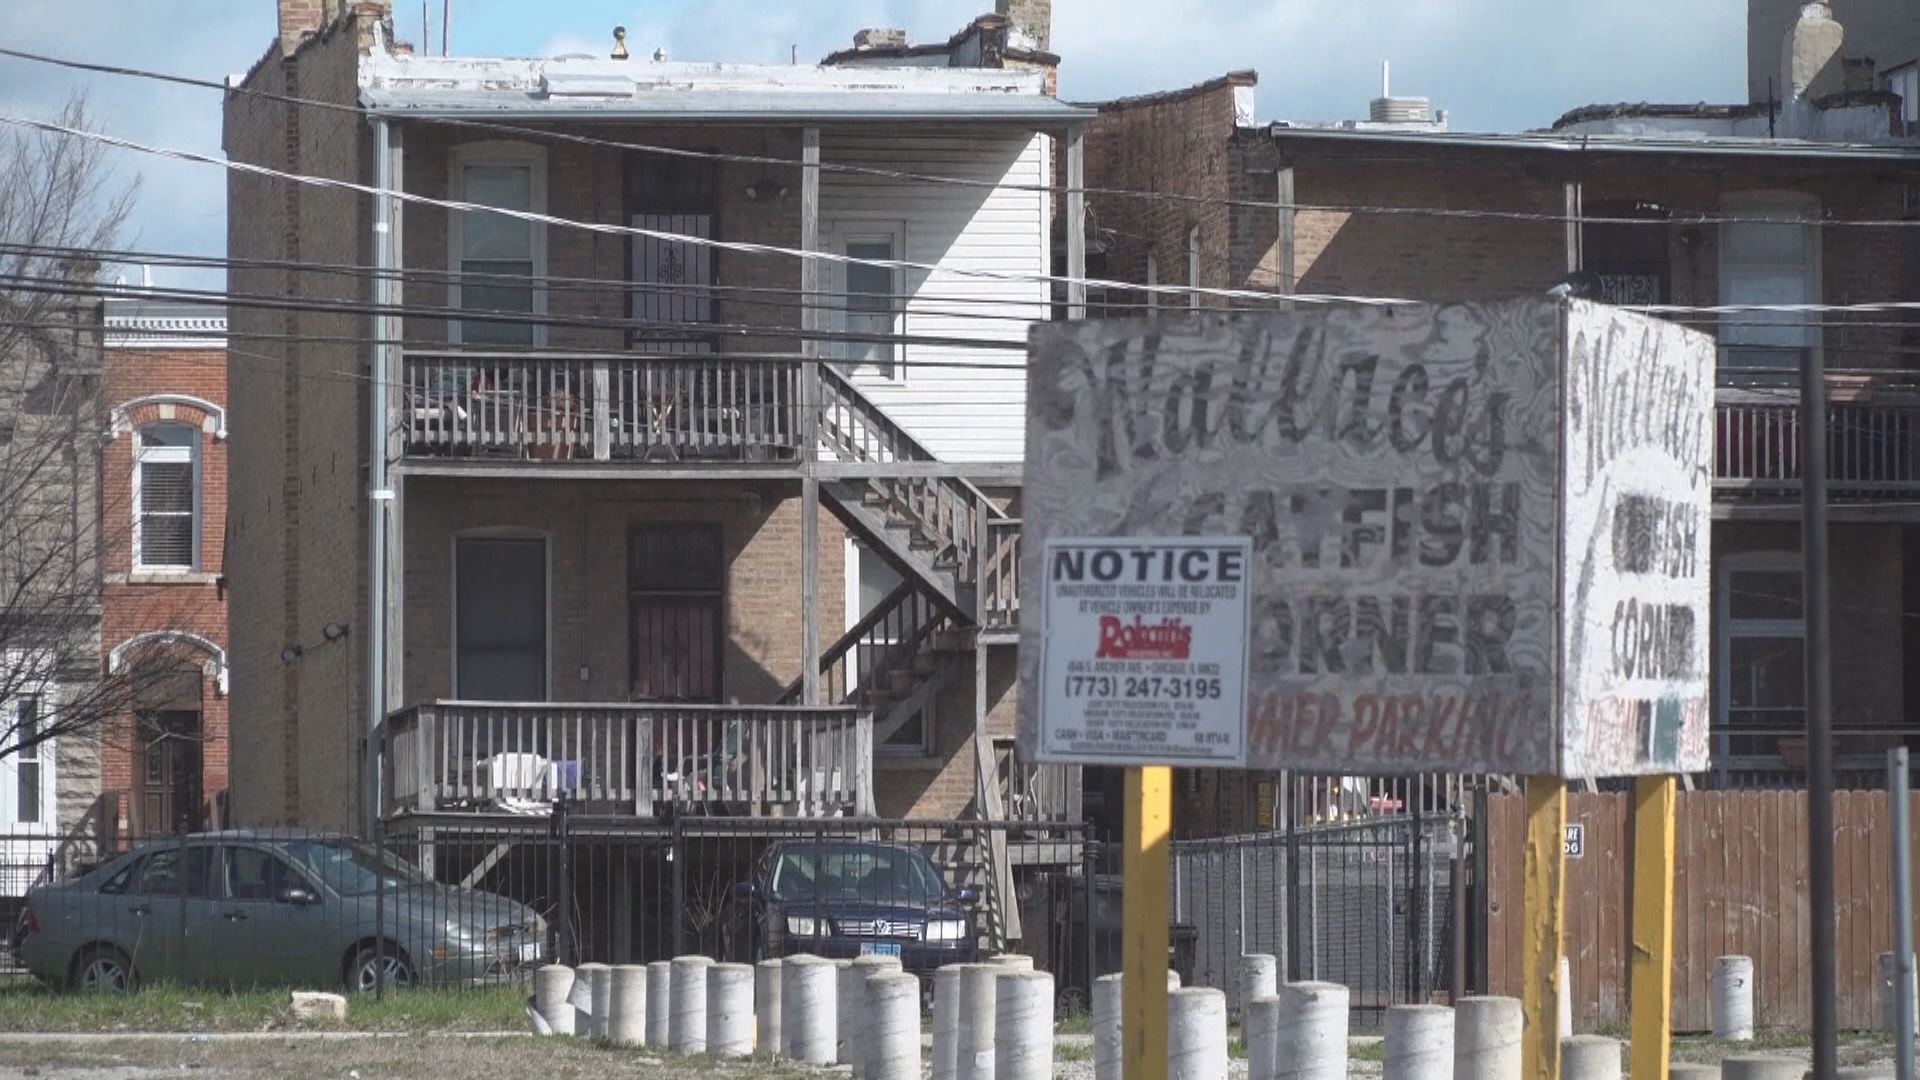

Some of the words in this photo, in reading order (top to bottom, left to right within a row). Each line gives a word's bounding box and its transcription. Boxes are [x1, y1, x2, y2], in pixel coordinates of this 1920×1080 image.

[1052, 550, 1242, 582] NOTICE
[1252, 593, 1517, 676] ORNER
[1065, 675, 1117, 698] (773)
[1125, 677, 1222, 699] 247-3195
[1055, 728, 1077, 740] CASH
